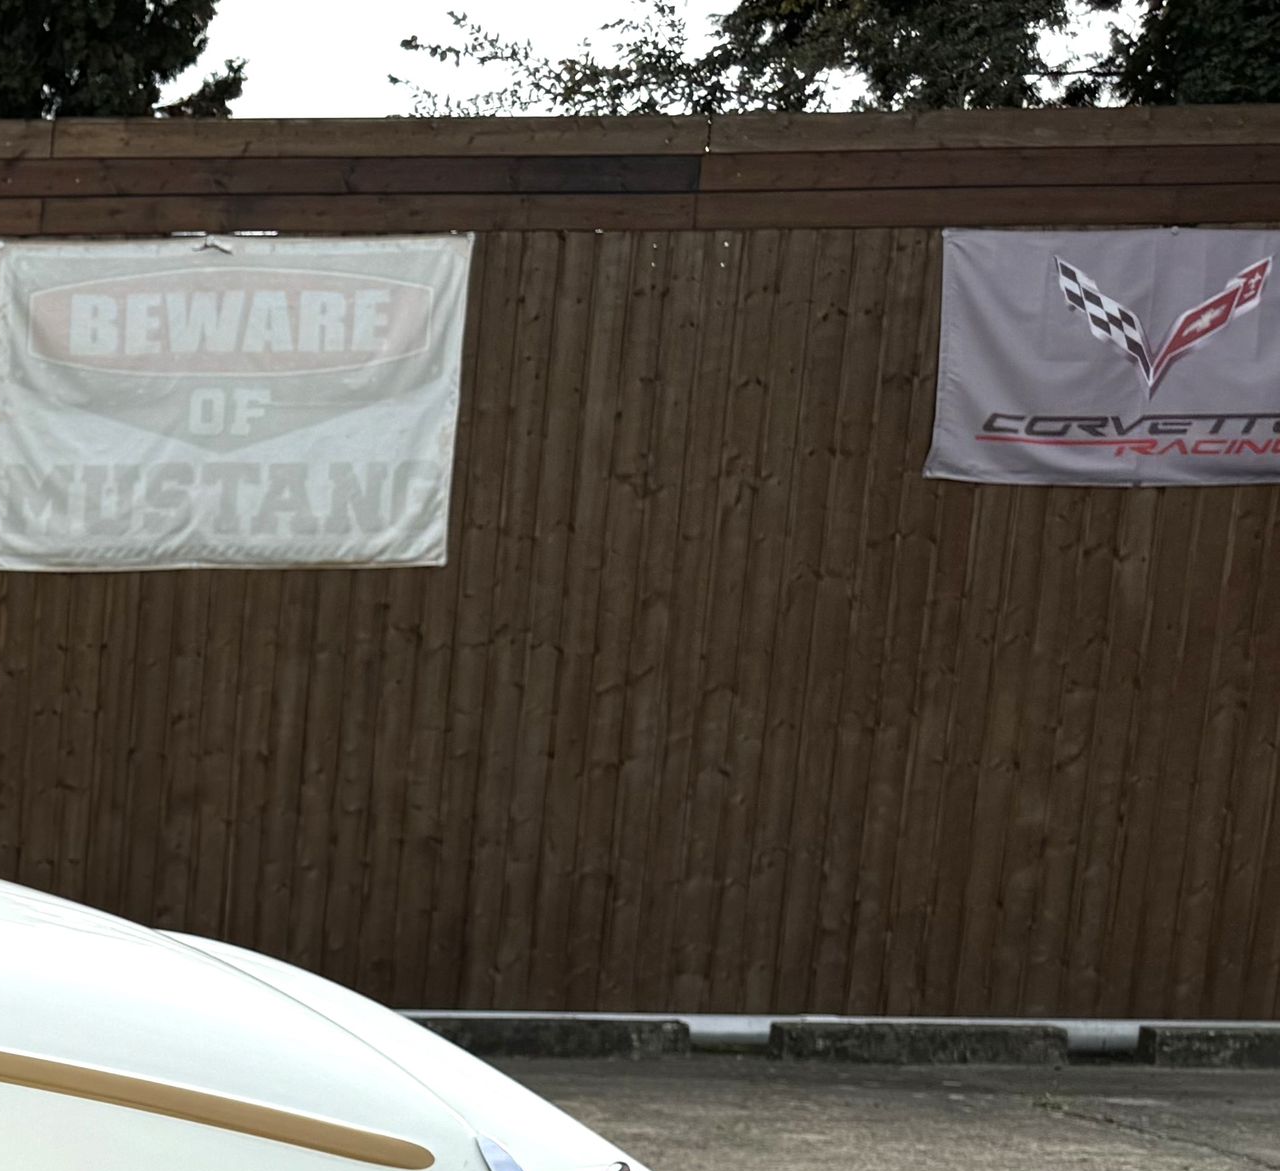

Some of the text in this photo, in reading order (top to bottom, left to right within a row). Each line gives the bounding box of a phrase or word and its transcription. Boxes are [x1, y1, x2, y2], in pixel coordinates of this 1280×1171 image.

[68, 289, 393, 356] BEWARE
[188, 387, 272, 437] OF
[1114, 438, 1280, 458] RACIN
[0, 460, 443, 538] MUSTANG
